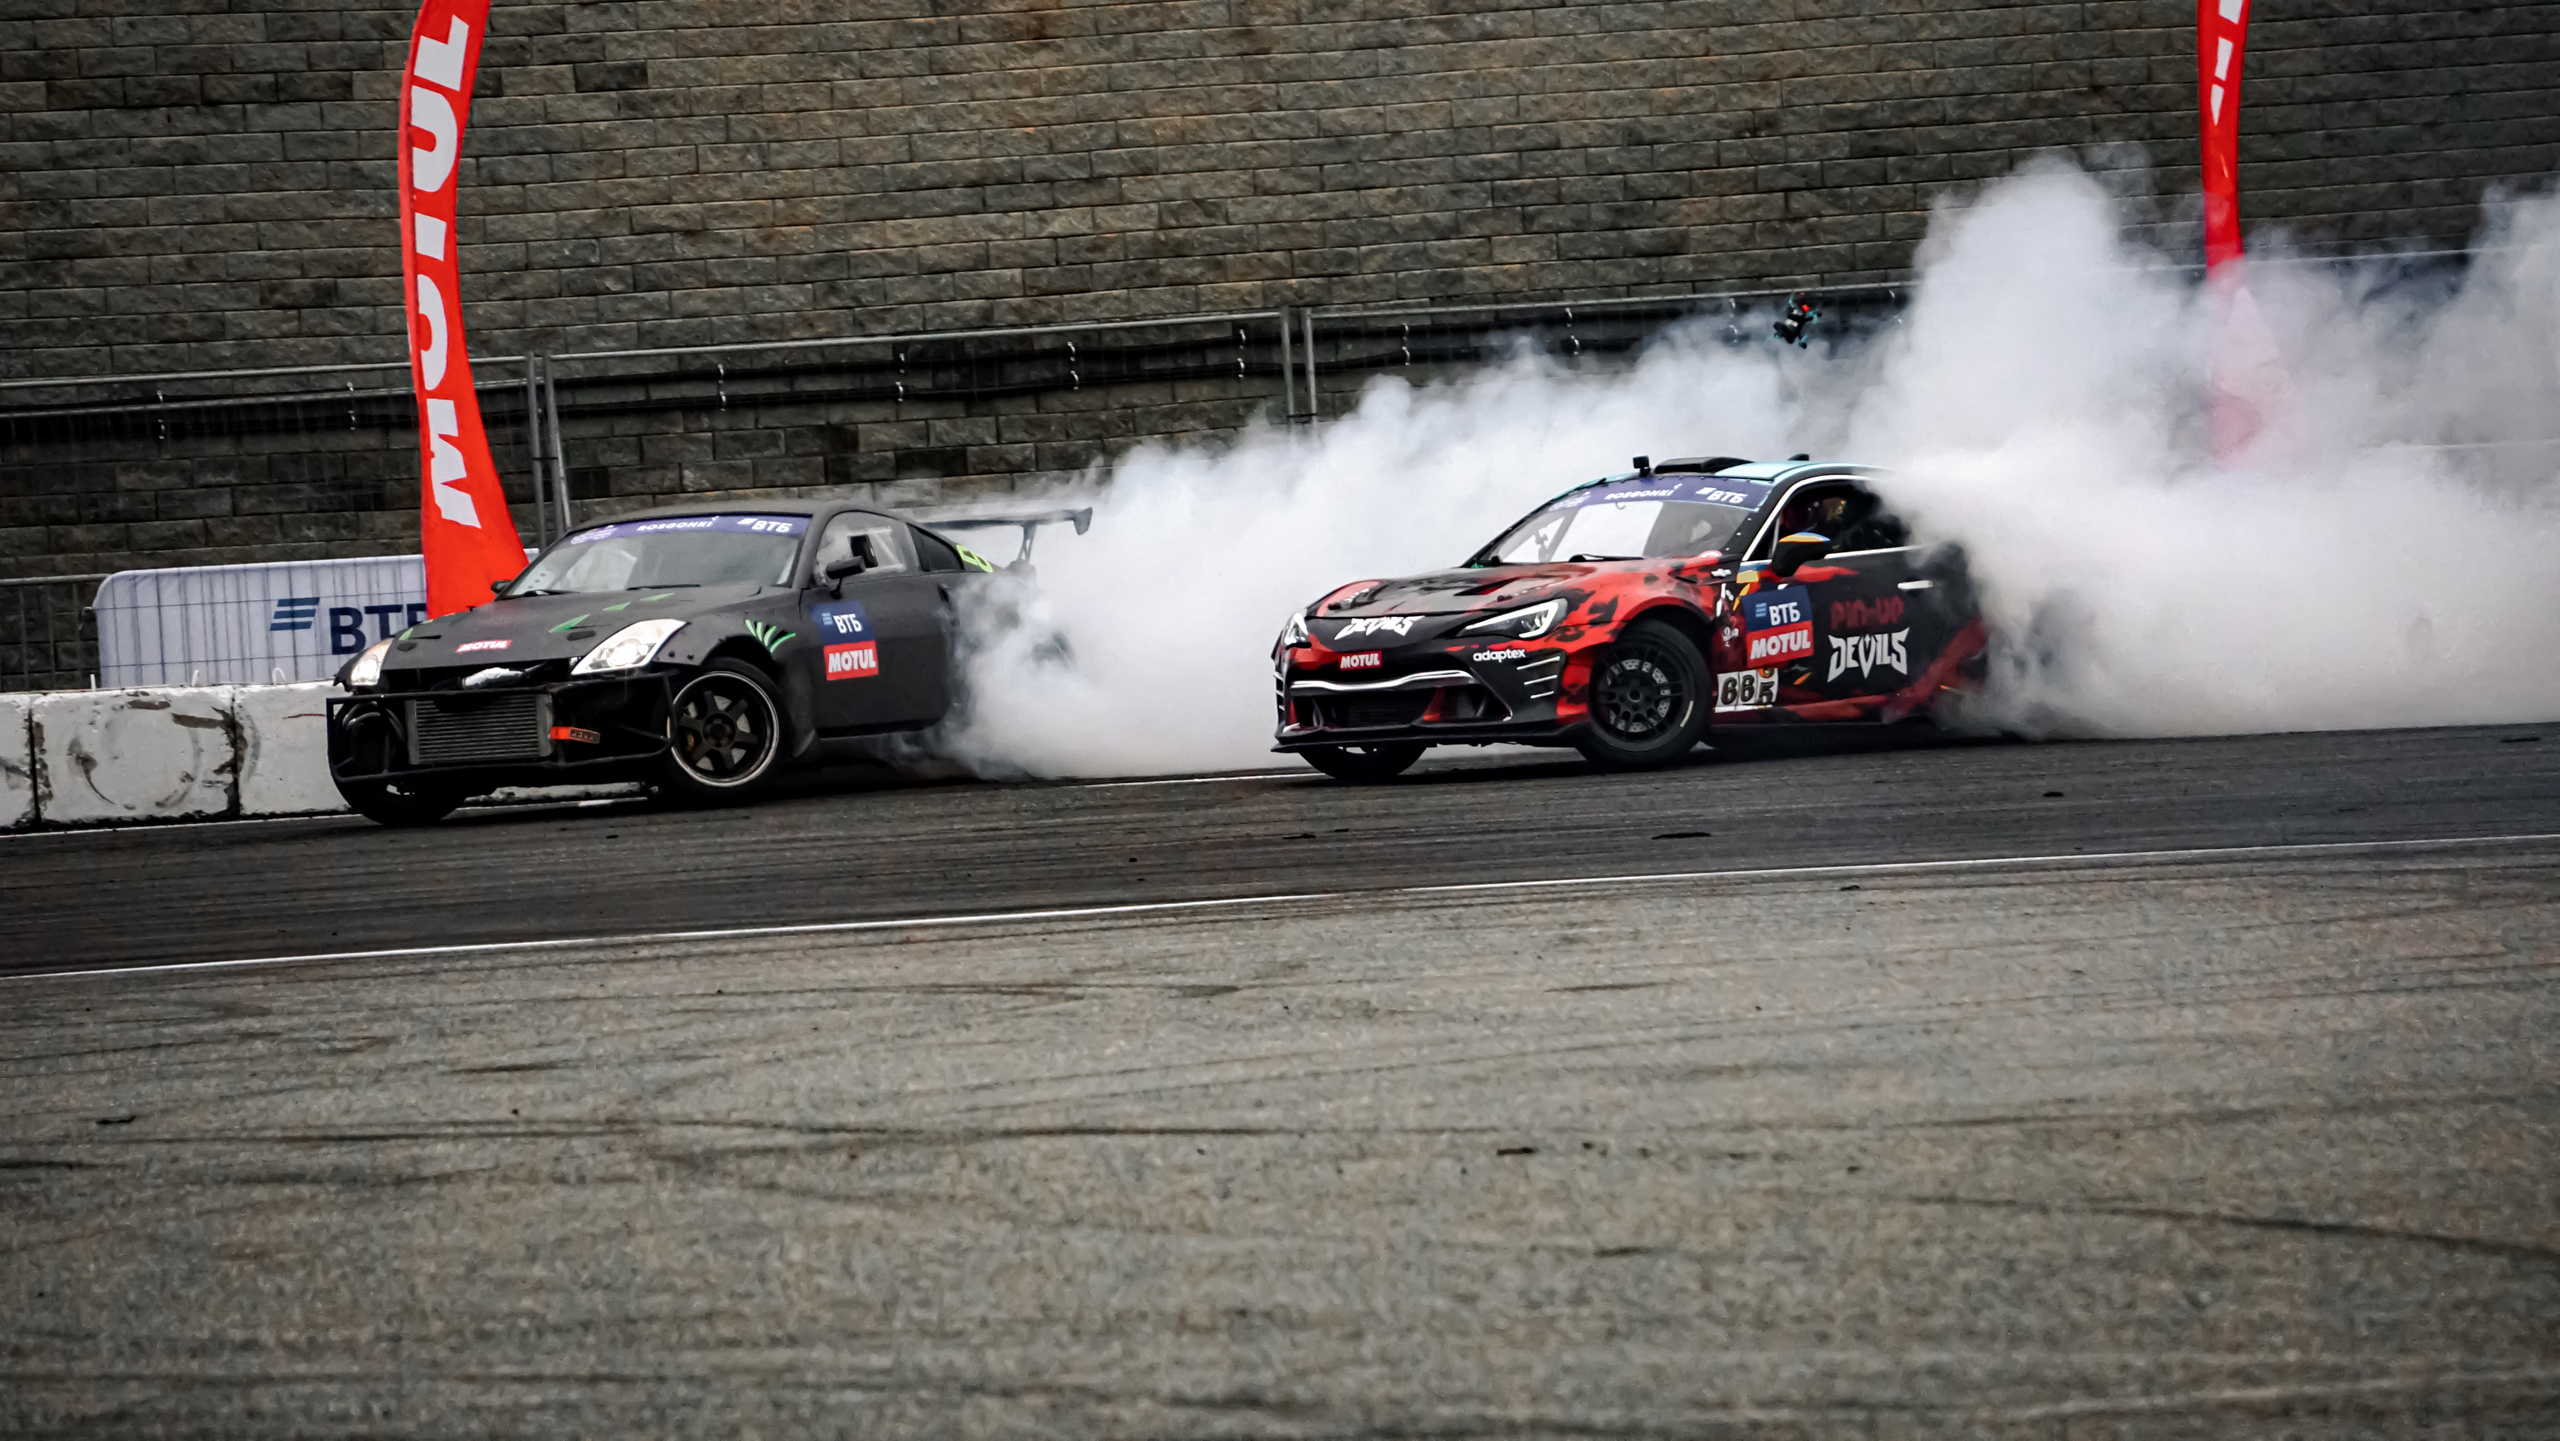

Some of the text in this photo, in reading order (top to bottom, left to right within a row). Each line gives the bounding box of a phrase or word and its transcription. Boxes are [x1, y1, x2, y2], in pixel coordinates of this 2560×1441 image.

[1706, 490, 1747, 504] ВТБ
[752, 519, 793, 533] ВТБ
[1769, 602, 1800, 626] ВТБ
[833, 613, 863, 634] ВТБ
[461, 639, 509, 652] MOTUL
[1750, 629, 1811, 660] MOTUL
[828, 649, 876, 673] MOTUL
[1341, 653, 1380, 669] MOTUL
[1473, 648, 1527, 663] adaptex
[1827, 627, 1910, 682] DEVILS
